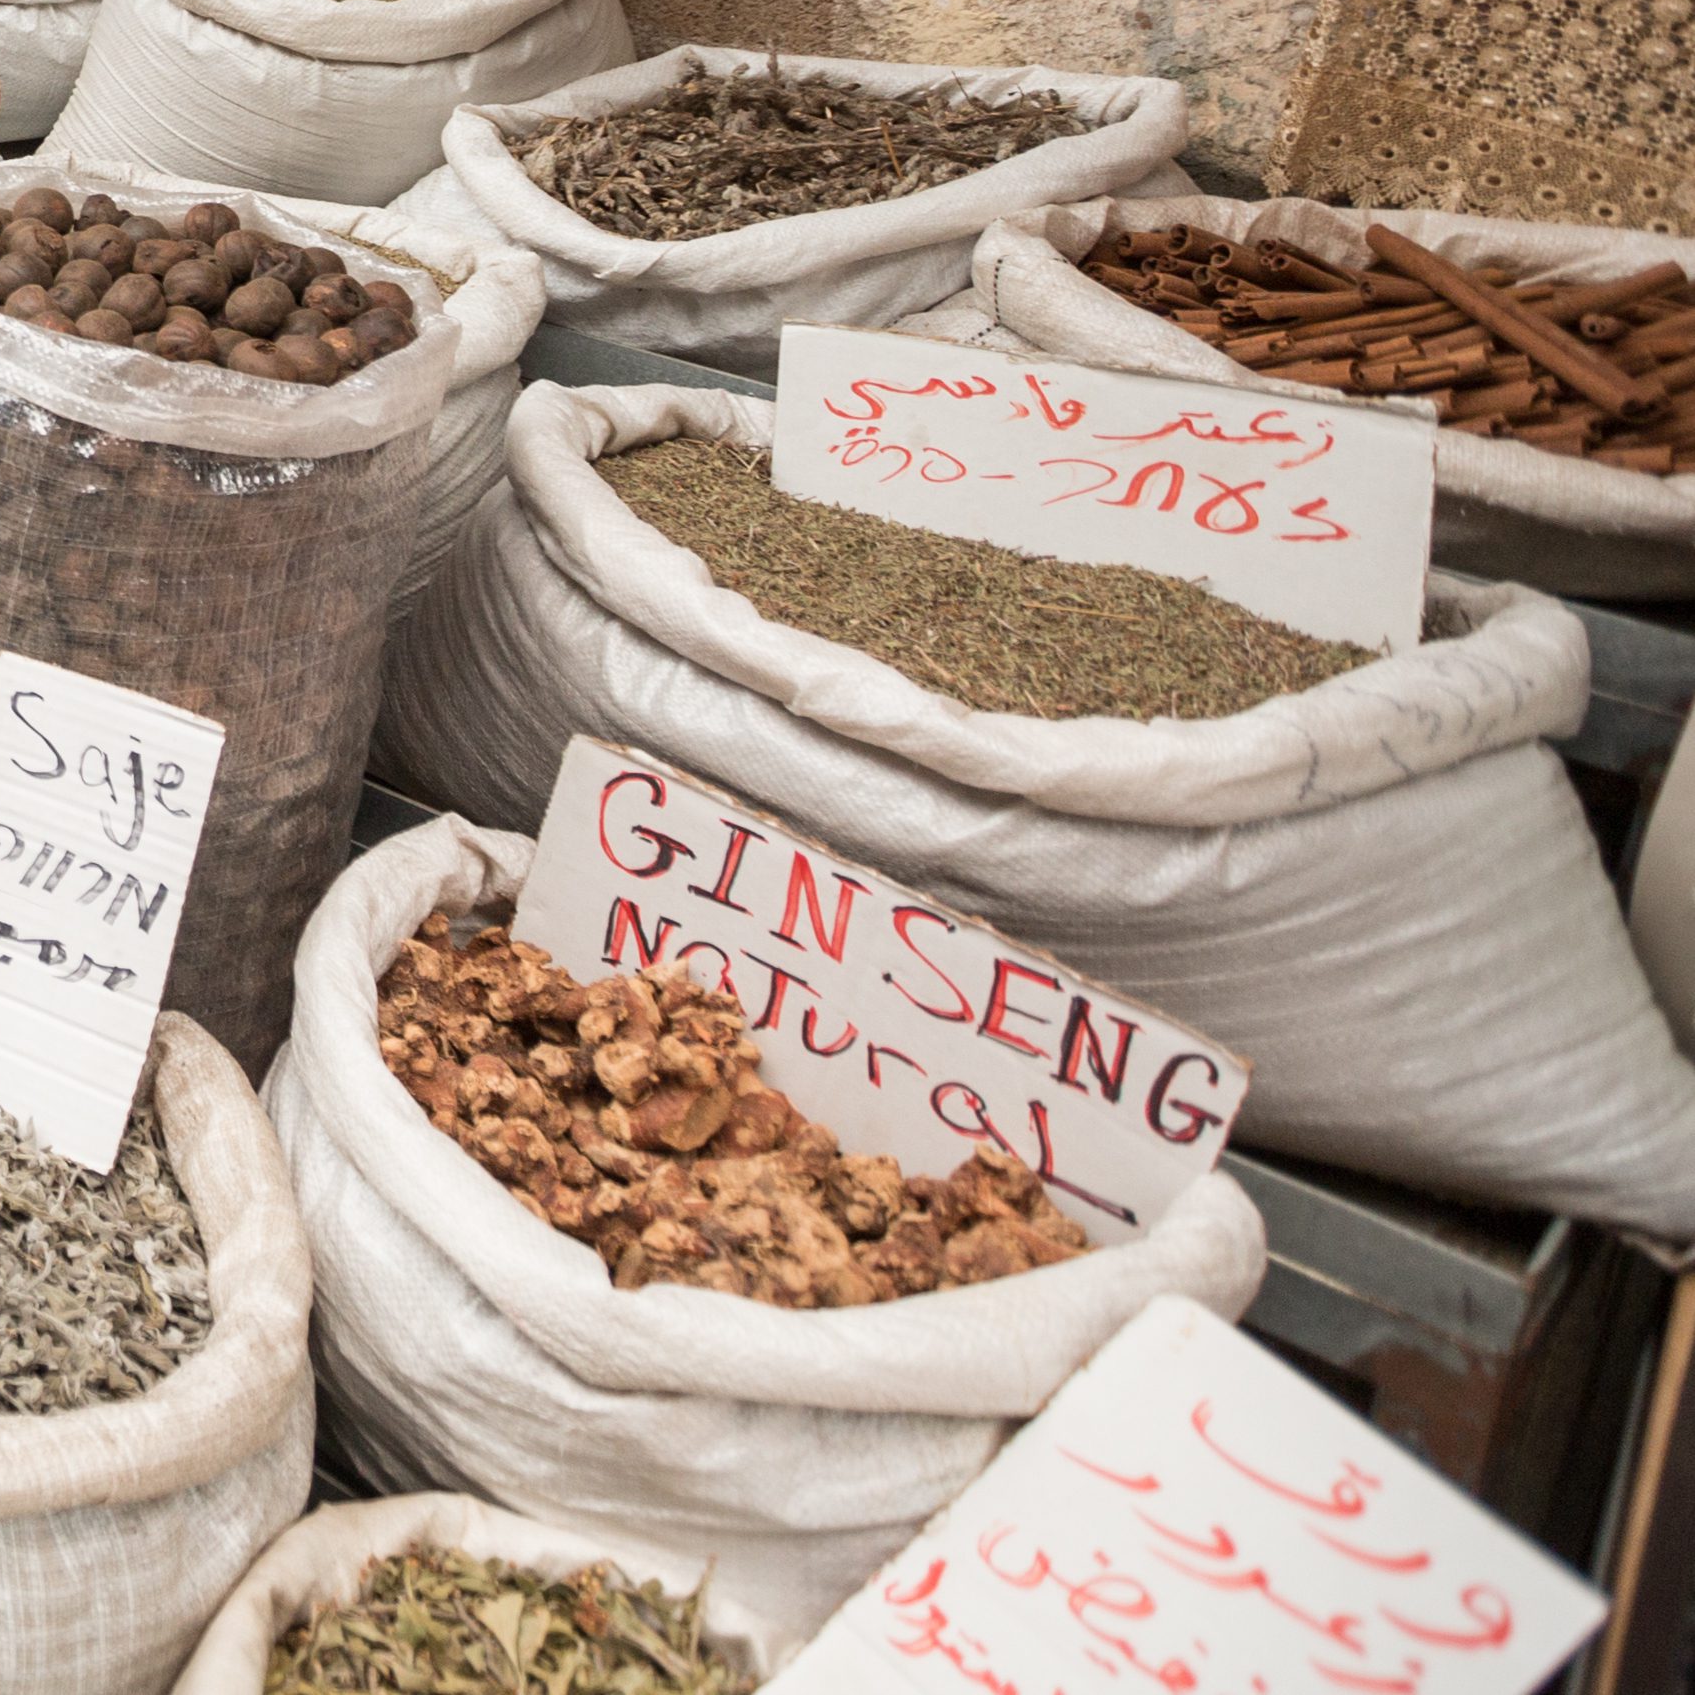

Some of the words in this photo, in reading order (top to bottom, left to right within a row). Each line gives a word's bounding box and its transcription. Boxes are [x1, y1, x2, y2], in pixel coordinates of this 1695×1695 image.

[1089, 410, 1336, 470] زعتر
[9, 690, 192, 852] Saje
[599, 771, 1223, 1146] GINSENG
